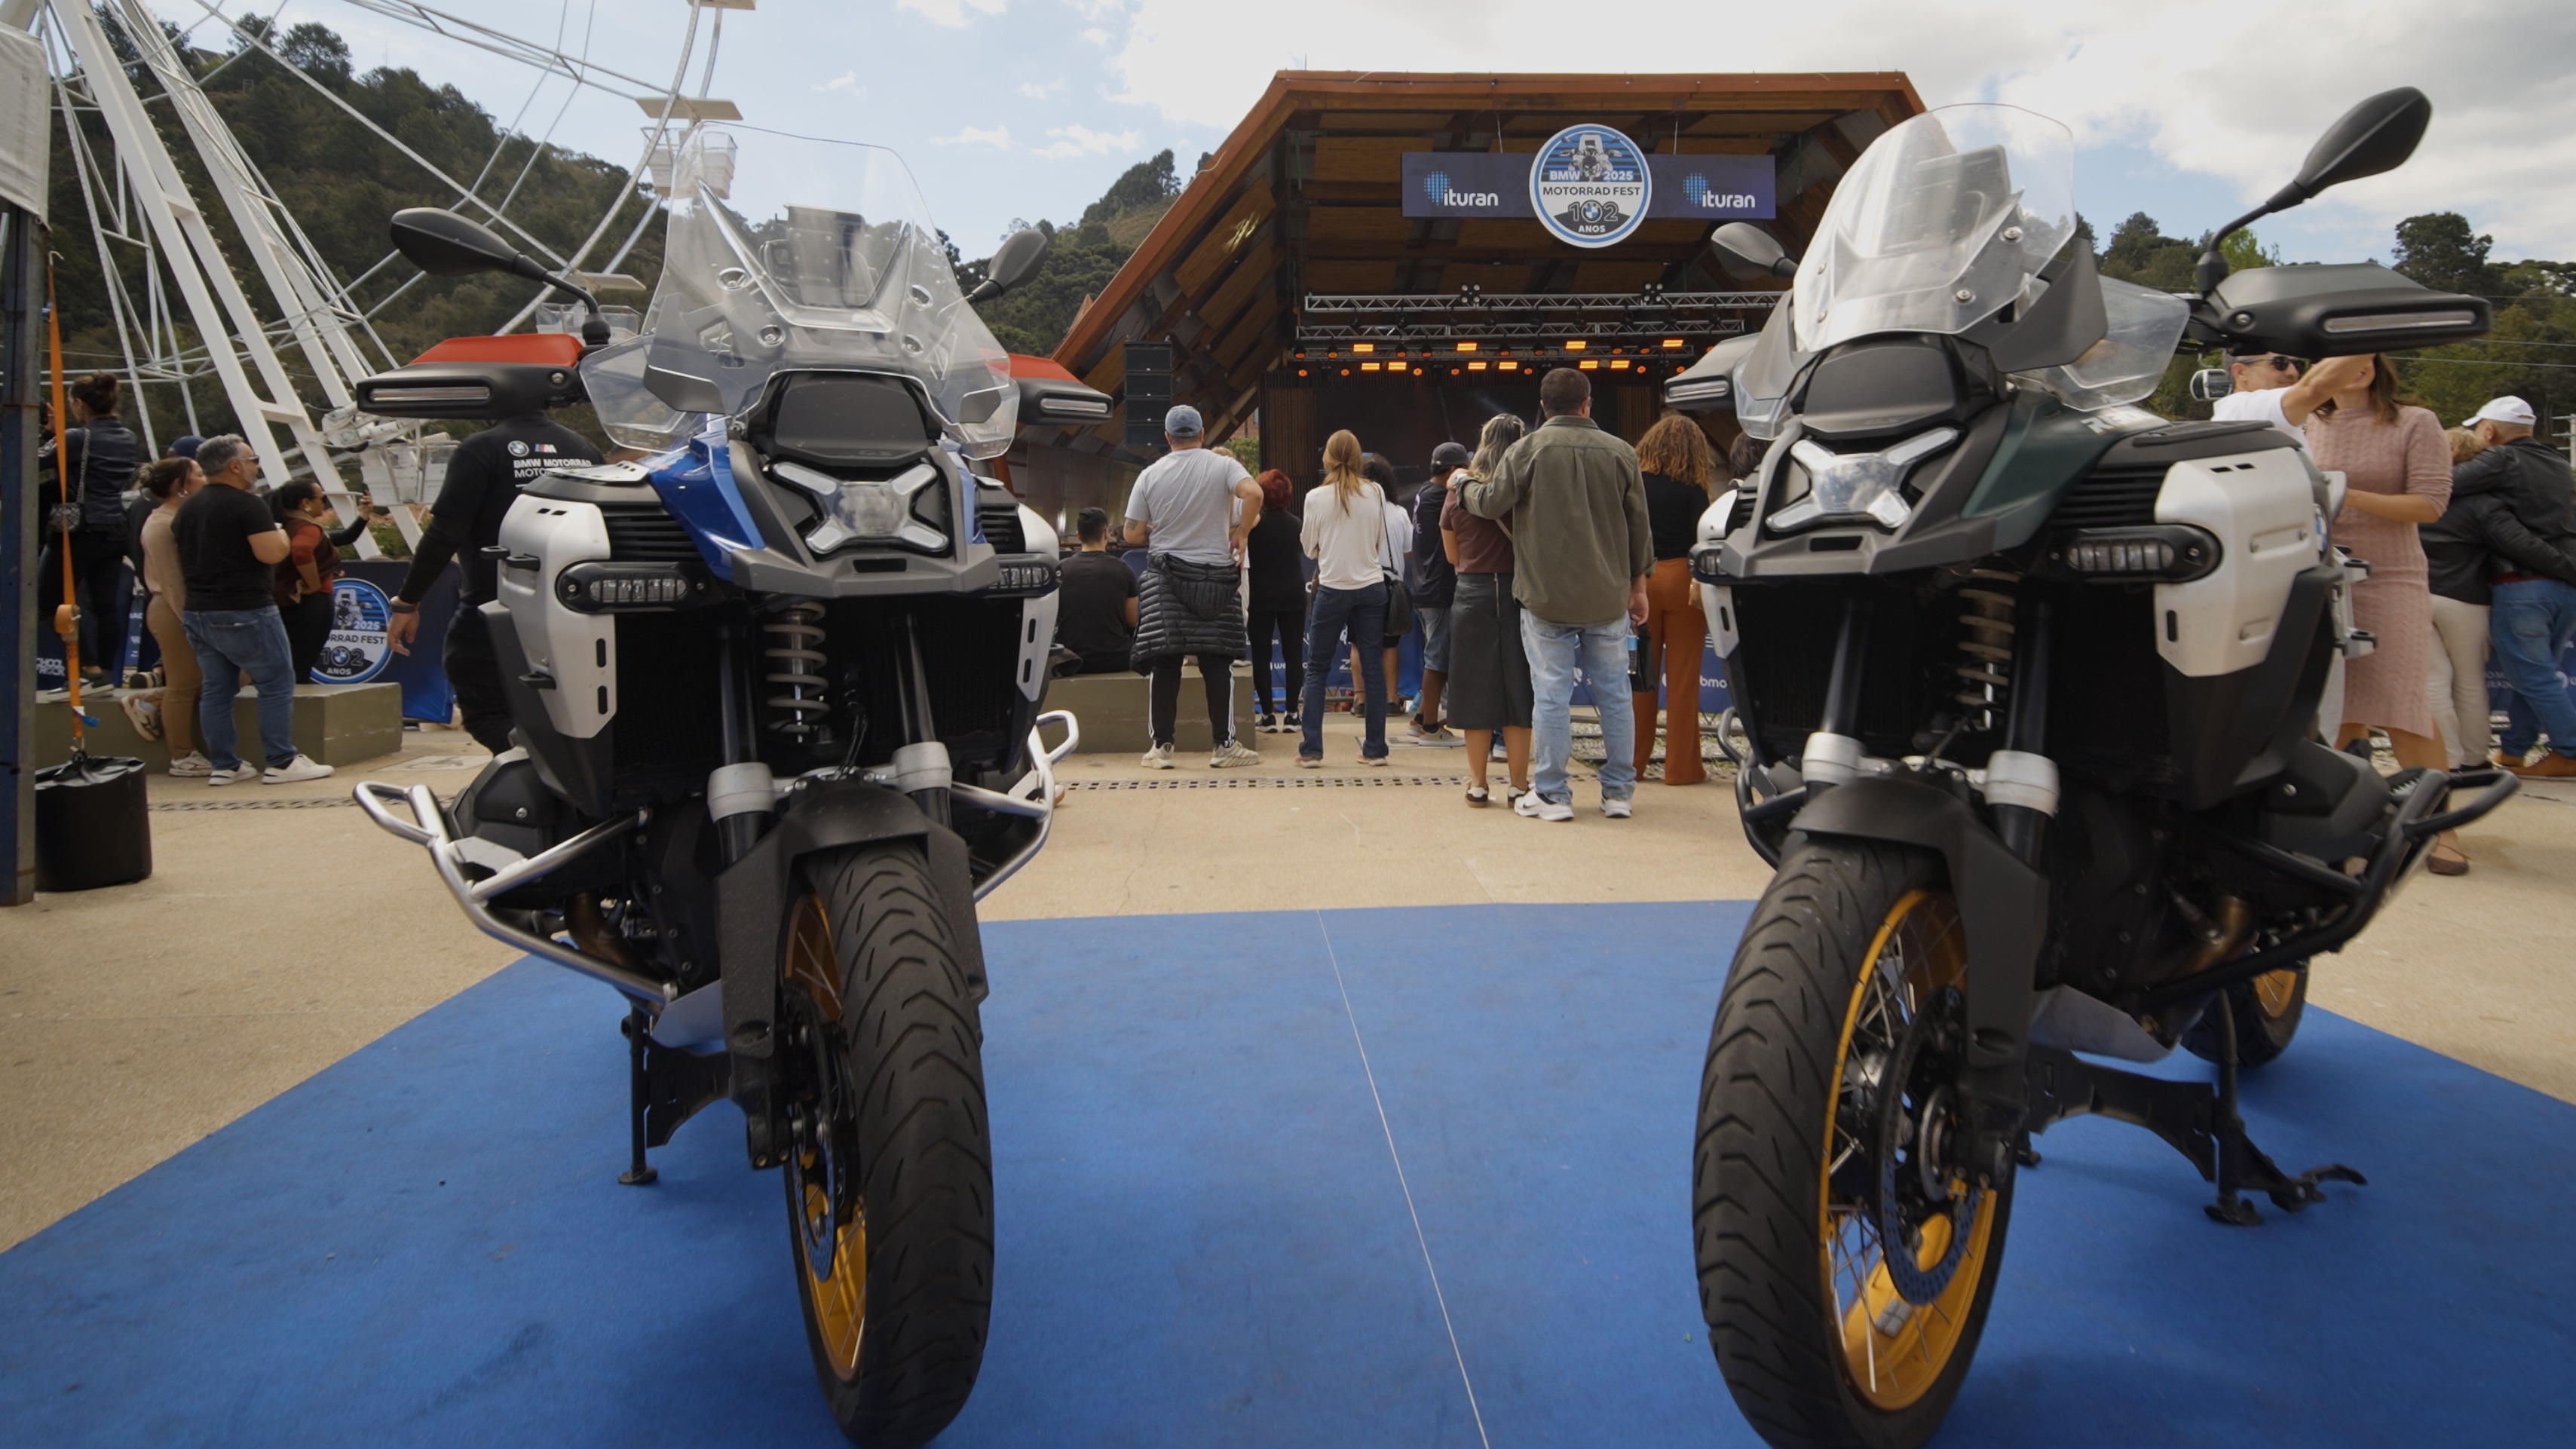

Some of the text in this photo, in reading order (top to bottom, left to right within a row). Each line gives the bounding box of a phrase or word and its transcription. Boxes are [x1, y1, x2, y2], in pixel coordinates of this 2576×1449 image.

[1549, 171, 1633, 180] BMW 2025
[1543, 187, 1640, 195] MOTORRAD FEST
[1444, 188, 1499, 207] ituran
[1702, 190, 1756, 208] ituran
[513, 459, 541, 468] BMW
[354, 621, 380, 630] 2025
[330, 634, 385, 644] RRAD FEST
[36, 657, 62, 666] CHOOL
